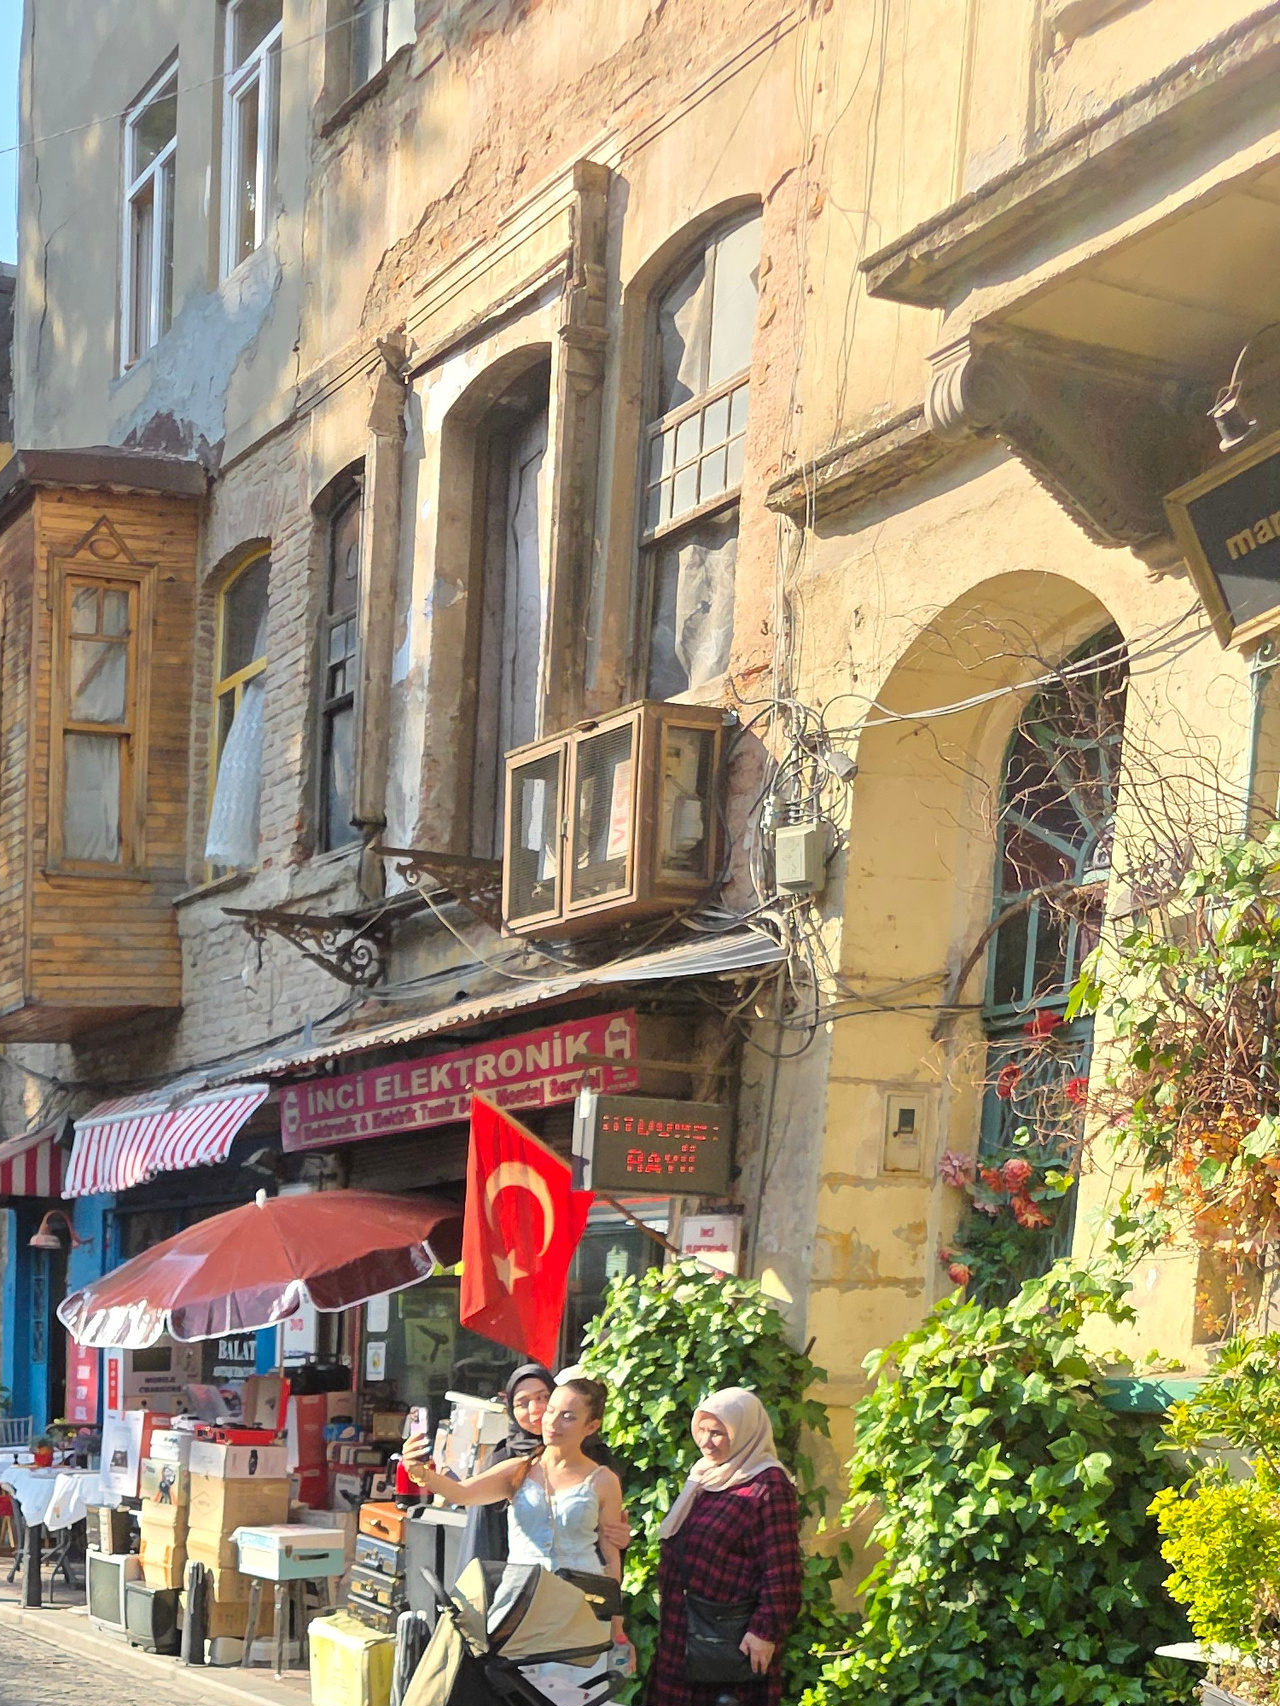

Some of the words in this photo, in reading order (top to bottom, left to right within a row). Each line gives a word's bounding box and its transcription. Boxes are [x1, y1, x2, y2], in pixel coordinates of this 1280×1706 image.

[307, 1075, 366, 1116] İNCİ
[375, 1031, 591, 1103] ELEKTRONİK
[218, 1339, 257, 1361] BALAT
